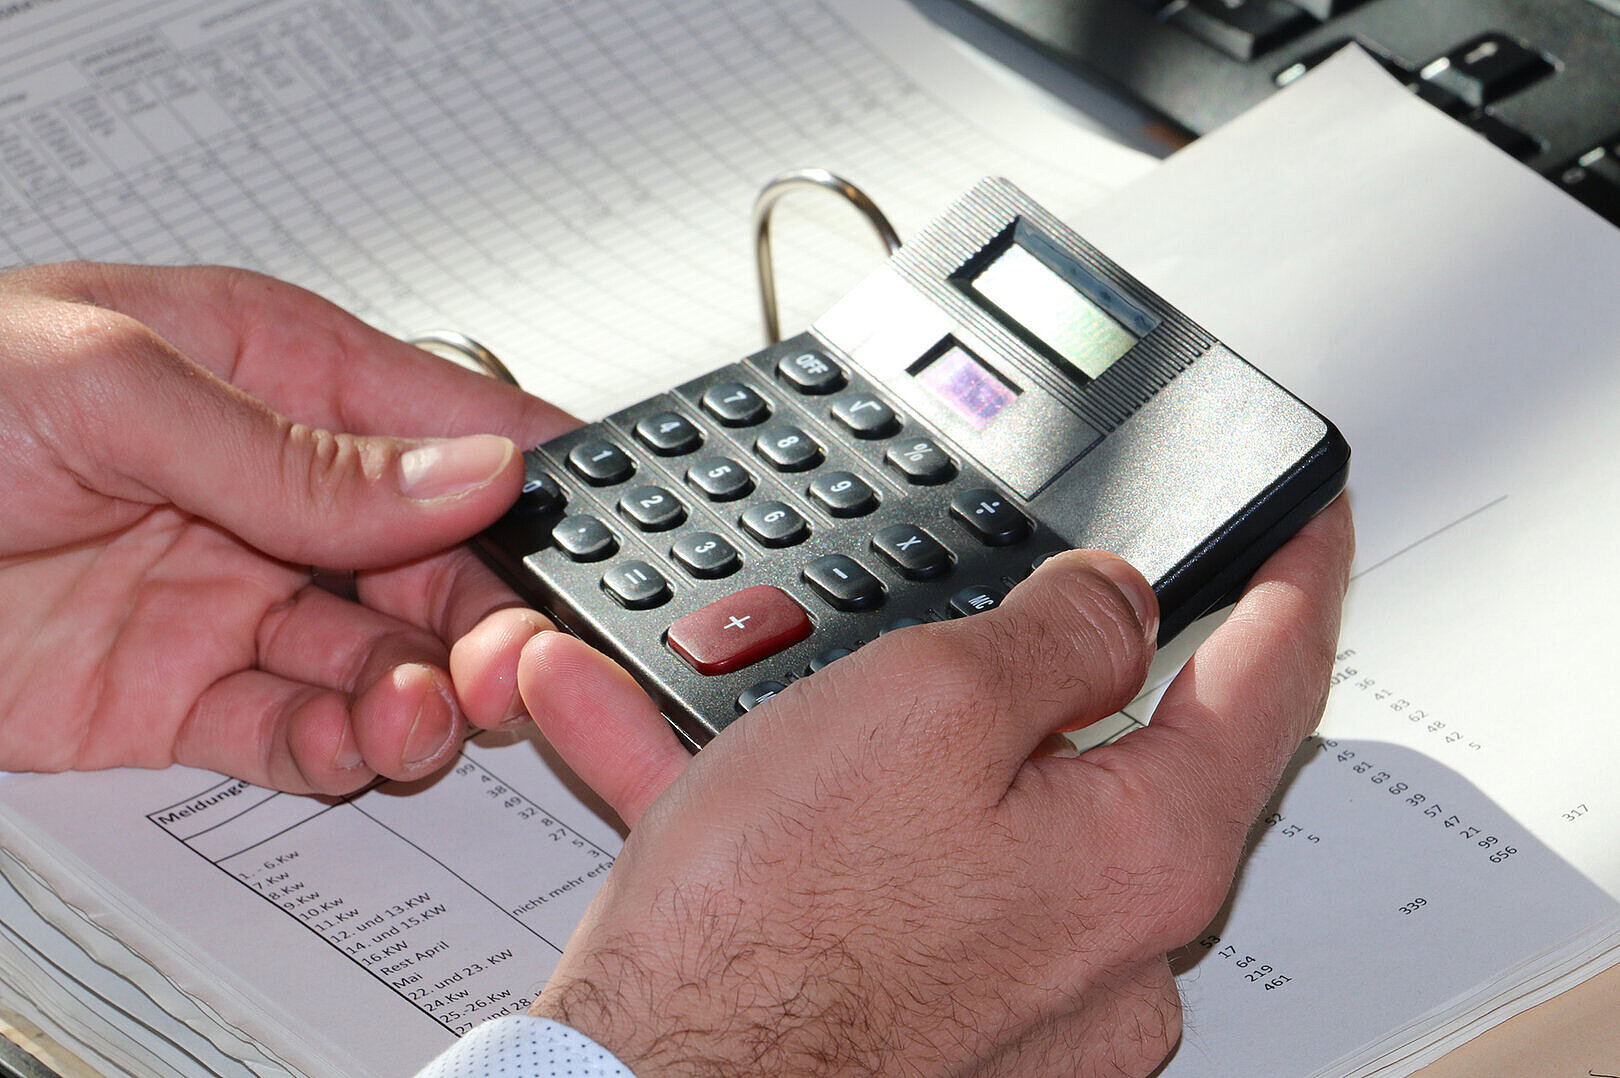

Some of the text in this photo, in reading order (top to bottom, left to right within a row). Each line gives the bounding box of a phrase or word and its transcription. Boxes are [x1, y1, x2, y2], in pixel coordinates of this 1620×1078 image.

[796, 353, 829, 375] OFF
[723, 390, 747, 404] 7
[660, 421, 681, 433] 4
[777, 435, 800, 449] 8
[592, 450, 613, 462] 1
[904, 443, 933, 462] %
[708, 465, 731, 478] 5
[830, 480, 852, 493] 9
[640, 495, 664, 508] 2
[764, 510, 786, 523] 6
[695, 541, 717, 553] 3
[968, 594, 994, 610] MC
[1335, 649, 1356, 662] en
[1330, 666, 1358, 688] 016
[1355, 677, 1376, 690] 36
[1374, 688, 1393, 702] 41
[1390, 699, 1411, 712] 83
[1408, 709, 1429, 722] 62
[1427, 720, 1446, 733] 48
[1445, 731, 1464, 744] 42
[1316, 739, 1338, 752] 76
[1469, 741, 1481, 751] 5
[1337, 750, 1355, 762] 45
[455, 763, 476, 777] 99
[1353, 761, 1374, 774] 81
[481, 775, 492, 783] 4
[1371, 771, 1391, 784] 63
[487, 785, 508, 799] 38
[1388, 782, 1408, 795] 60
[504, 796, 522, 809] 49
[1405, 793, 1426, 807] 39
[518, 807, 537, 820] 32
[1424, 804, 1442, 818] 57
[1561, 804, 1589, 822] 317
[541, 818, 553, 827] 8
[1265, 812, 1286, 827] 52
[1444, 815, 1460, 828] 47
[548, 828, 567, 841] 27
[1282, 824, 1303, 838] 51
[1459, 826, 1481, 839] 21
[572, 838, 584, 848] 5
[1307, 834, 1320, 844] 5
[1478, 836, 1498, 849] 99
[587, 850, 600, 858] 3
[1489, 846, 1517, 863] 656
[512, 896, 549, 916] nicht
[548, 876, 585, 898] mehr
[1398, 897, 1427, 915] 339
[330, 930, 356, 943] 12.
[356, 914, 385, 932] und
[346, 942, 371, 955] 14.
[372, 926, 401, 943] und
[1200, 935, 1221, 949] 53
[380, 940, 450, 976] Rest April
[1218, 945, 1236, 959] 17
[1236, 955, 1256, 968] 64
[408, 949, 513, 1000] 22. und 23. KW
[1244, 964, 1273, 982] 219
[392, 972, 424, 989] Mai
[1264, 974, 1292, 991] 461
